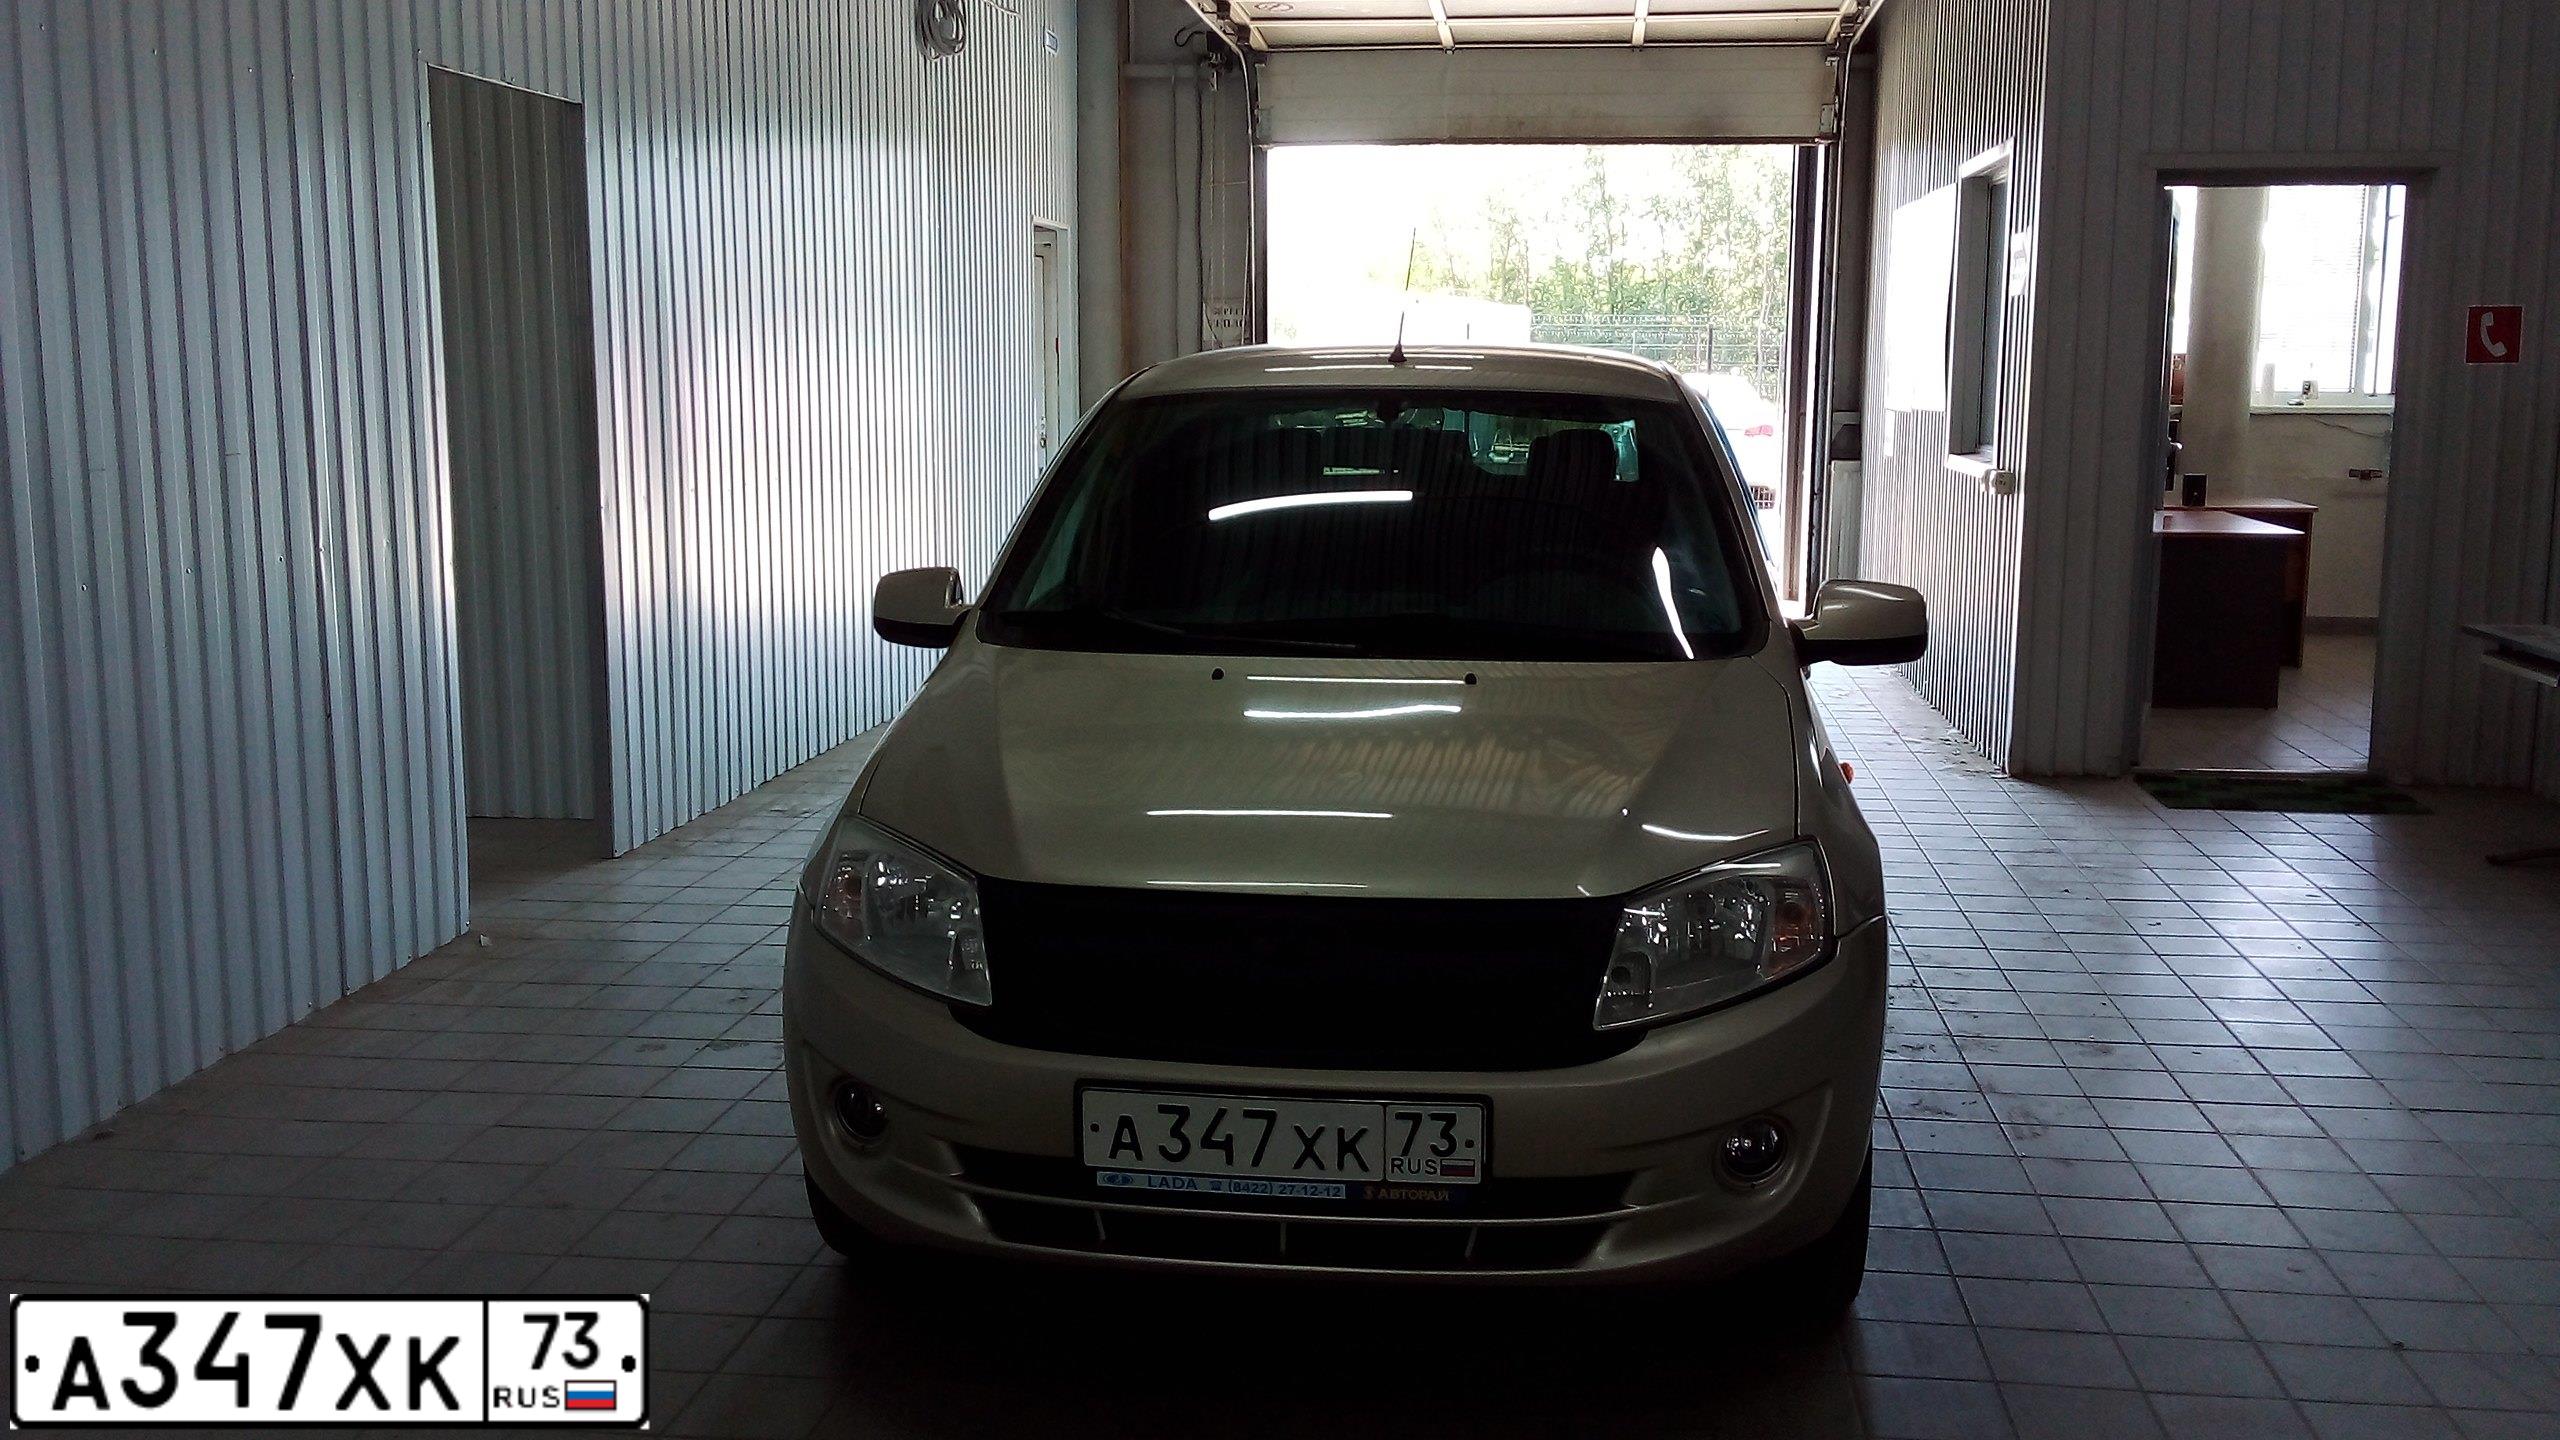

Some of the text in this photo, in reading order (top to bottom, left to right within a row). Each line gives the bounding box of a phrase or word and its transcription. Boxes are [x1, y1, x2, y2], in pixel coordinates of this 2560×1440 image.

[1394, 1112, 1457, 1157] 73
[1390, 1157, 1437, 1176] RUS
[1147, 1176, 1343, 1198] LADA (8422) 27-12-12
